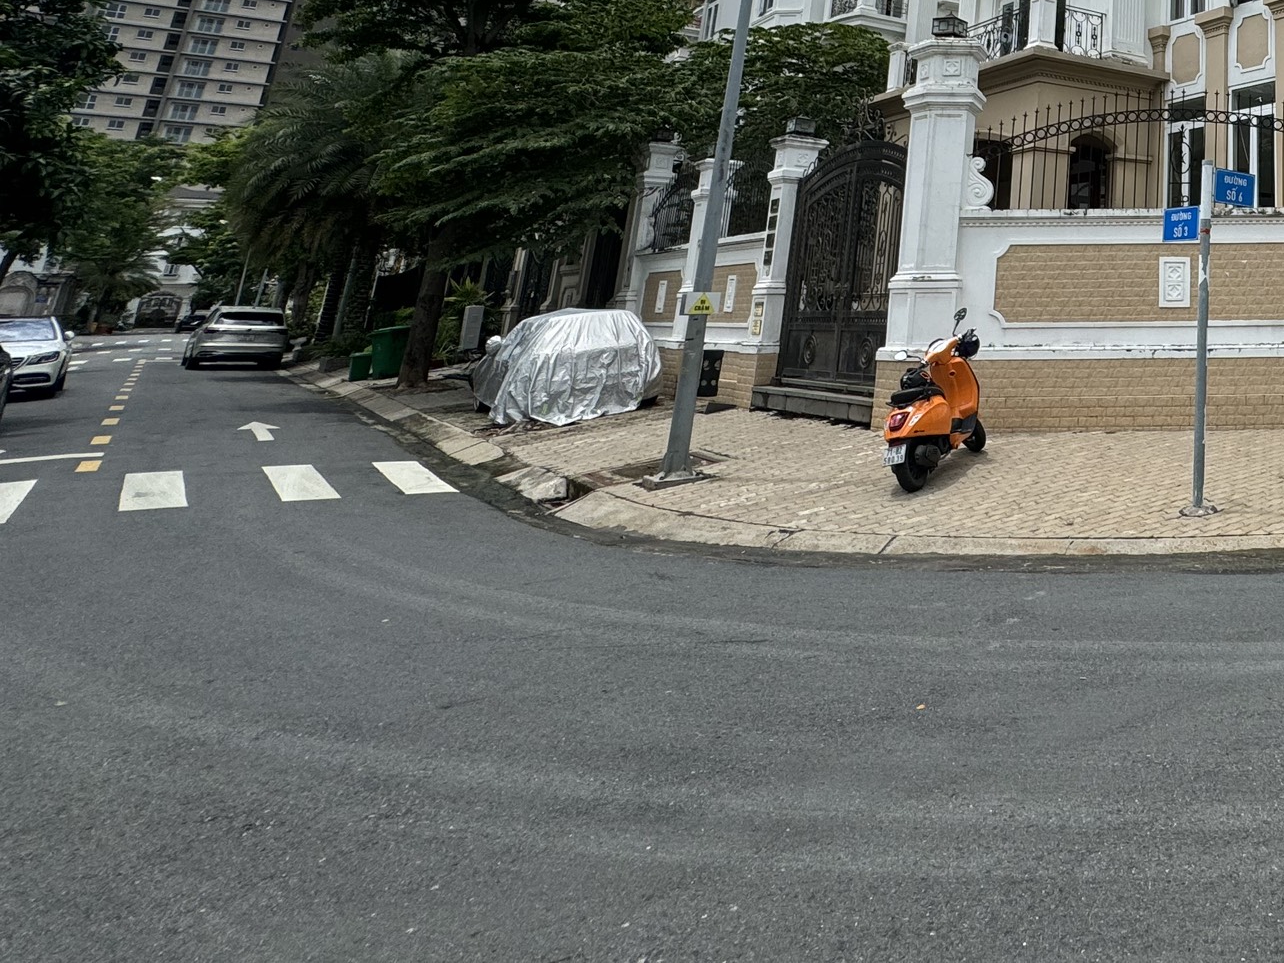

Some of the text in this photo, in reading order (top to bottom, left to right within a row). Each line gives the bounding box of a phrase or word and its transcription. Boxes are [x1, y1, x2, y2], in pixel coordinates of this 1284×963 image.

[1224, 175, 1247, 187] ĐƯỜNG
[1226, 186, 1243, 202] SỐ 6
[1170, 211, 1192, 222] ĐƯỜNG
[1173, 222, 1188, 238] SỐ 3
